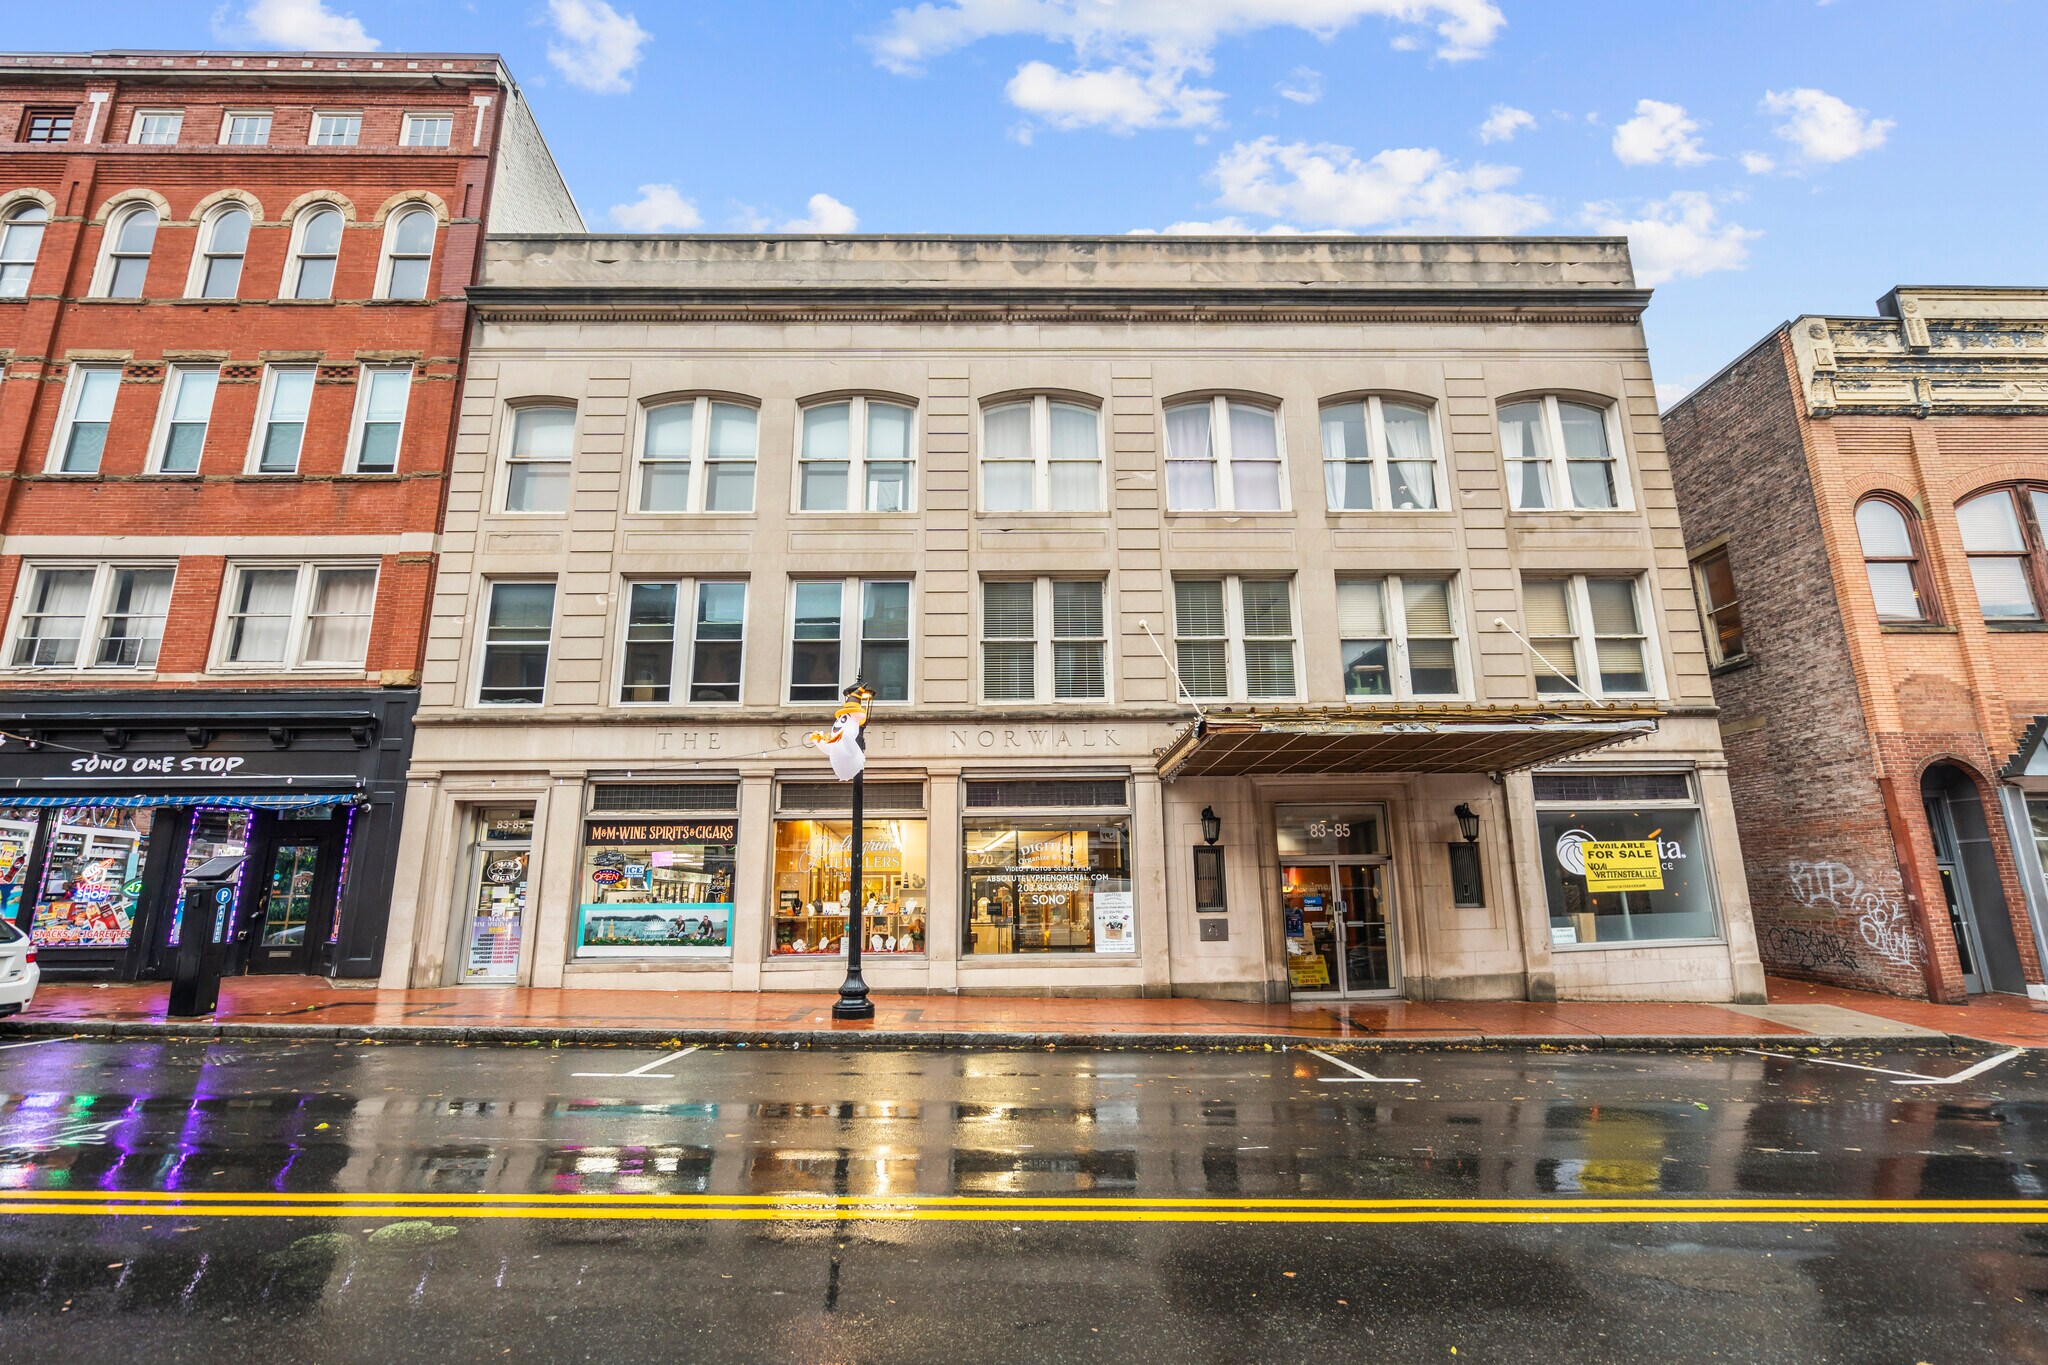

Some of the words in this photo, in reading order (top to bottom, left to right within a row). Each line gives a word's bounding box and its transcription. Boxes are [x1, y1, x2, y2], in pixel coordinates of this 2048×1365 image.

[658, 731, 722, 750] THE
[778, 731, 897, 749] SOH
[951, 729, 1121, 750] NORWALK
[71, 757, 127, 773] SONO
[132, 756, 175, 773] ONE
[180, 756, 244, 773] STOP
[296, 805, 317, 818] 83
[496, 820, 525, 829] 83-85
[1310, 823, 1351, 838] 83-85
[1020, 842, 1077, 856] DIGITIZE
[1588, 850, 1614, 859] FOR
[1619, 849, 1653, 858] SALE
[825, 856, 900, 868] JEWLERS
[593, 872, 619, 881] OPEN
[986, 873, 1109, 883] ABSOLUTELYPHENOMENAL.COM
[76, 889, 107, 899] SHOP
[1032, 894, 1066, 905] SONO
[34, 930, 68, 938] SNACKS
[77, 930, 131, 938] CIGARETTES
